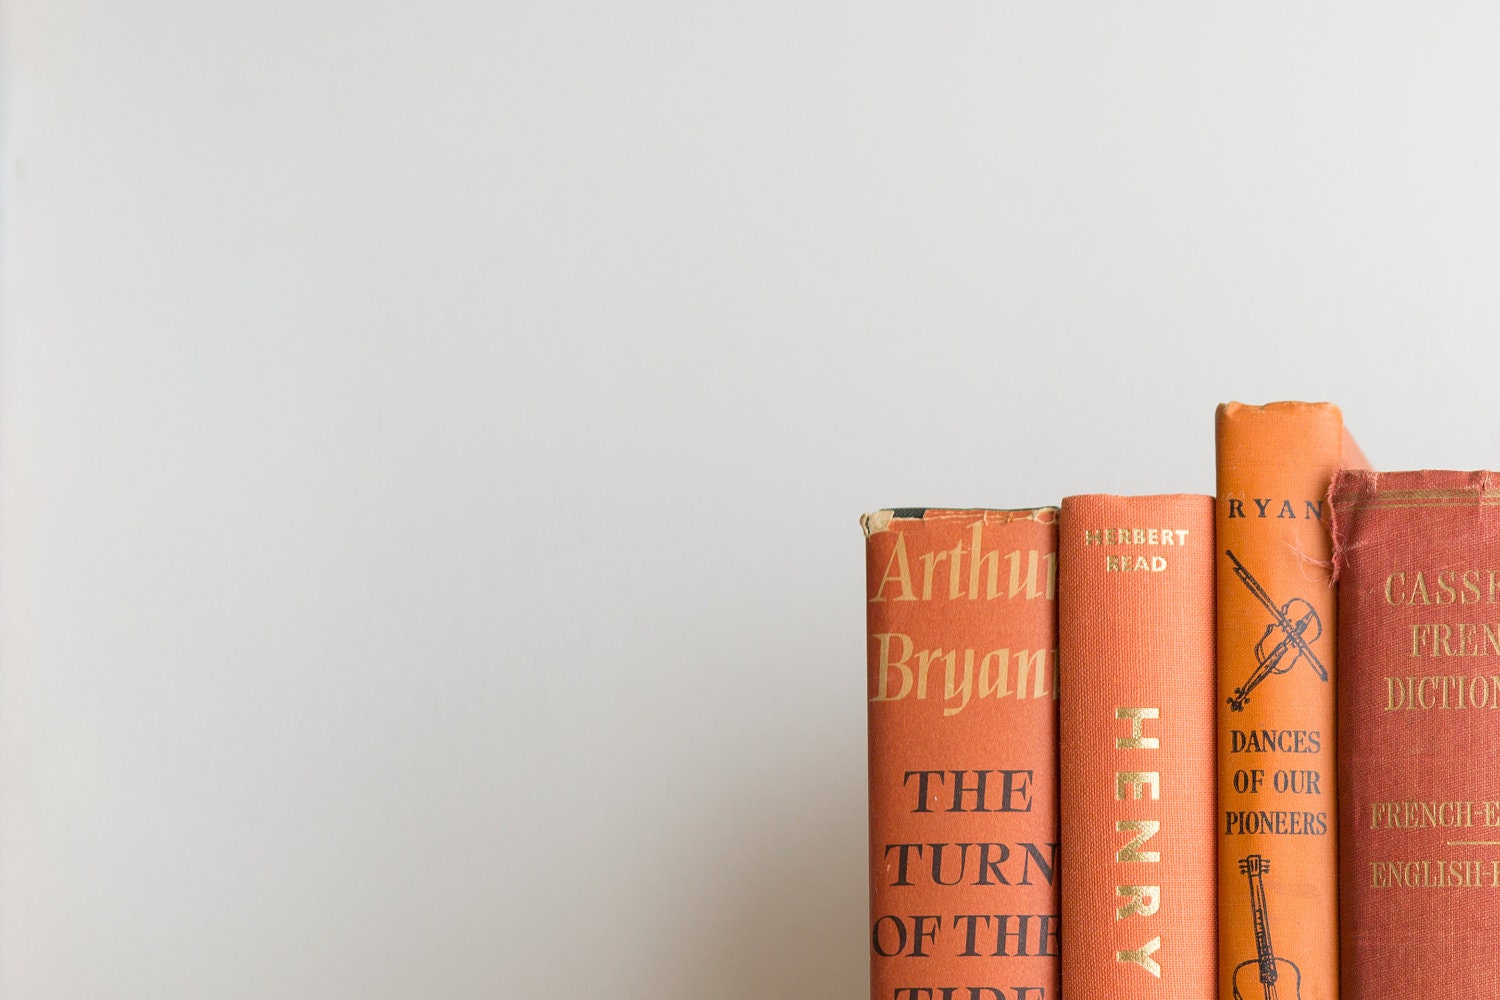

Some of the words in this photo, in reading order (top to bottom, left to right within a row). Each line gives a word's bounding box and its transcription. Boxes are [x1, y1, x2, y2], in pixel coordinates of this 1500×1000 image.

[1227, 498, 1324, 520] RYAN
[1085, 527, 1190, 547] HERBERT
[1106, 555, 1168, 573] READ
[1230, 729, 1322, 755] DANCES
[903, 769, 1034, 814] THE
[1232, 768, 1265, 796] OF
[1272, 768, 1322, 796] OUR
[1224, 811, 1328, 837] PIONEERS
[1114, 706, 1162, 979] HENRY
[884, 842, 1058, 887] TURN
[872, 914, 942, 958] OF
[953, 914, 1059, 958] THE
